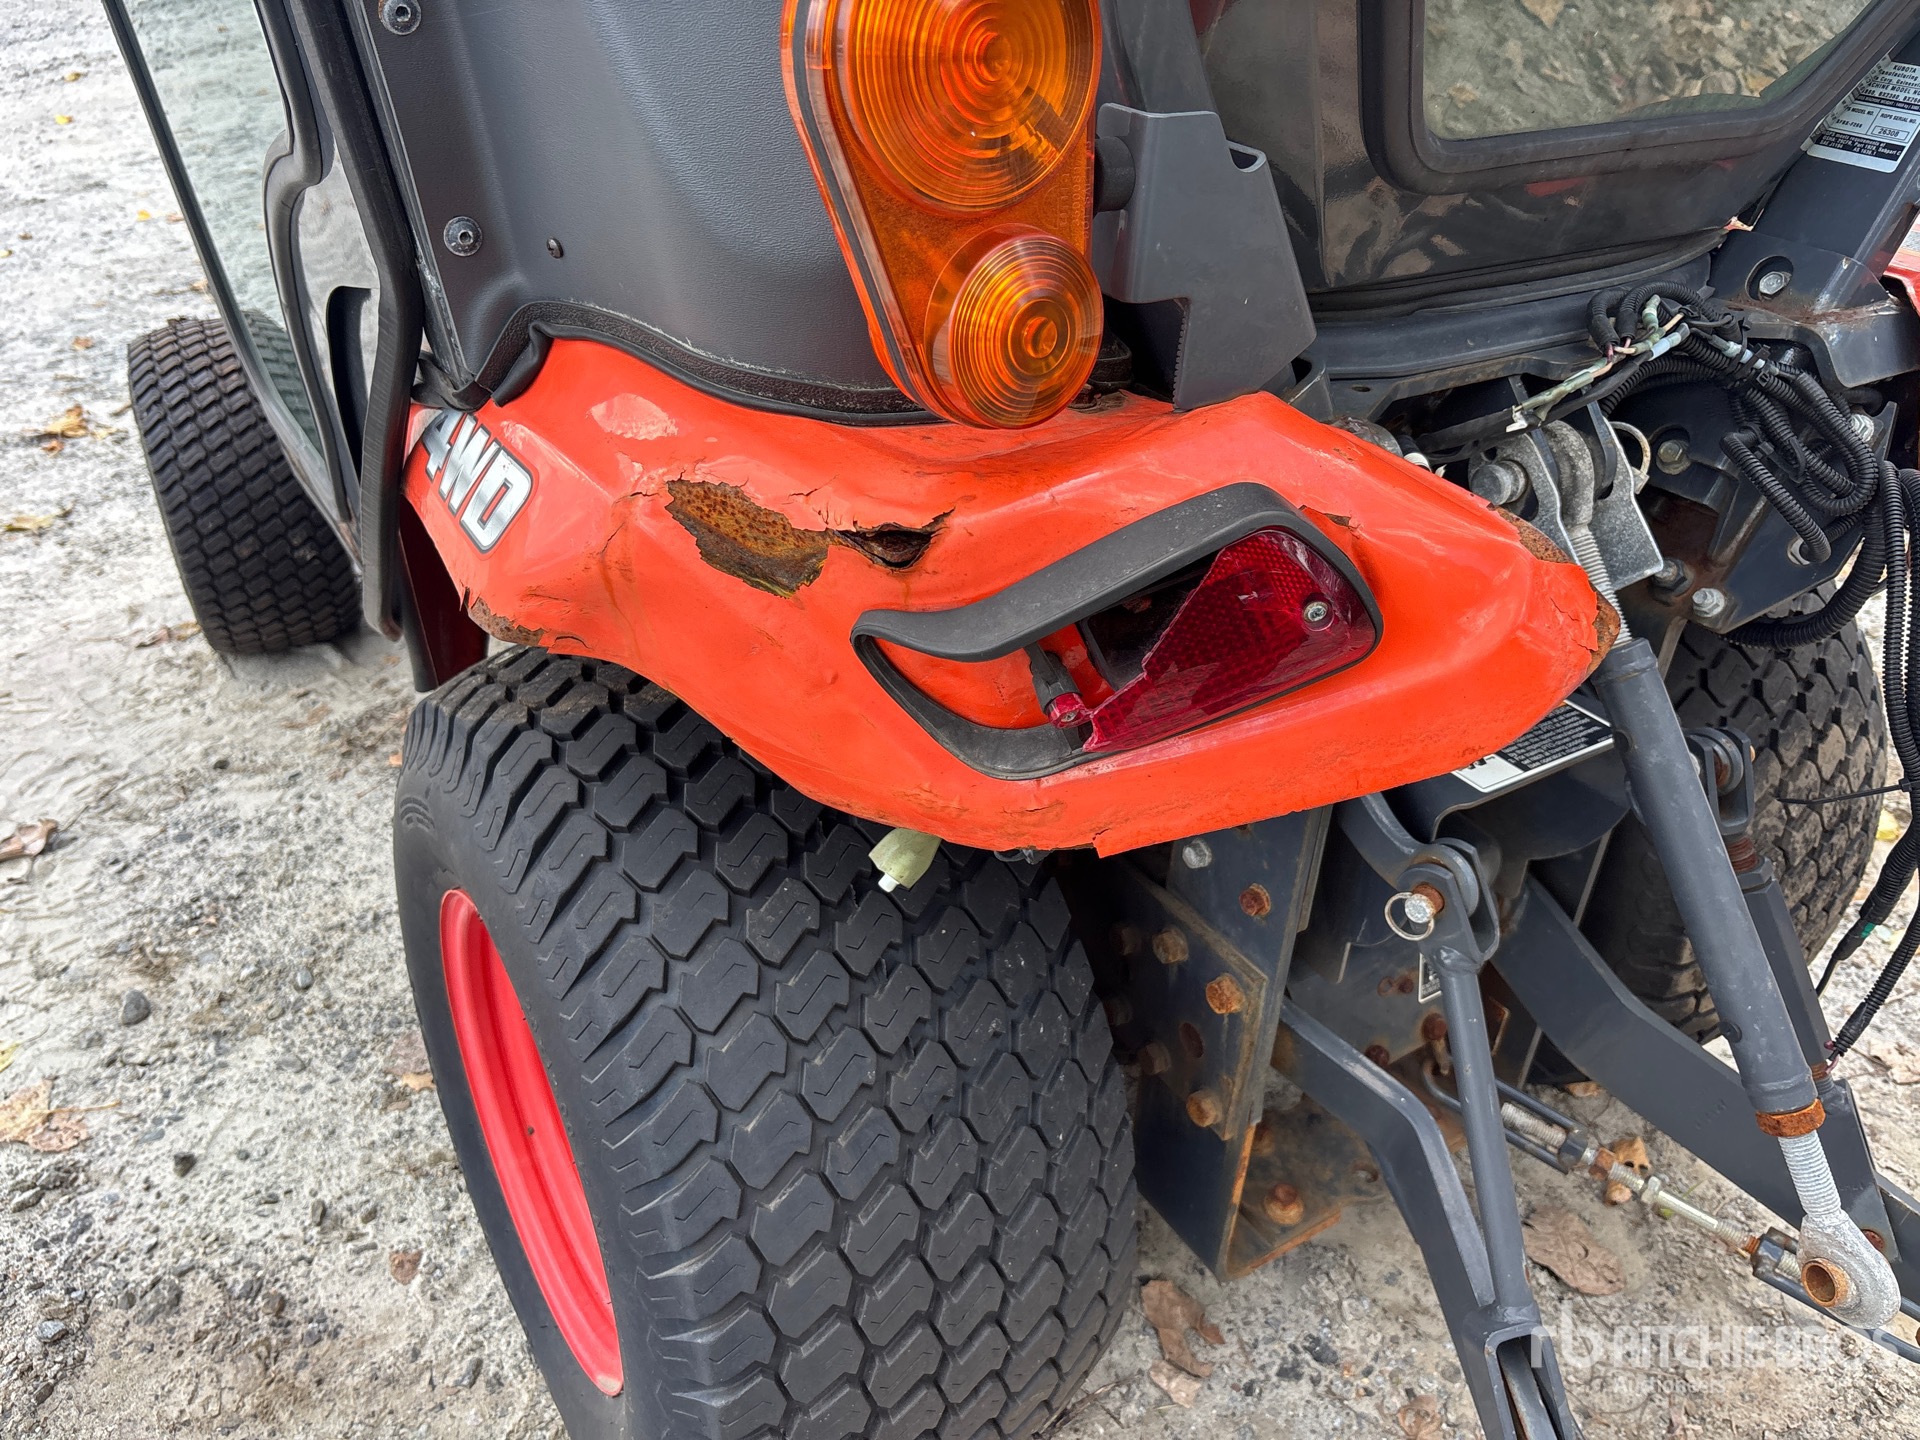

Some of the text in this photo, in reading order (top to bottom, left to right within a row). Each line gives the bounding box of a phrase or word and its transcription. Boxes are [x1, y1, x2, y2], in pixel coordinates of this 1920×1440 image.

[1893, 65, 1917, 73] KUBOTA
[1890, 86, 1911, 94] MODEL
[1893, 115, 1908, 123] SERIAL
[1877, 128, 1900, 138] 26308
[1850, 136, 1880, 146] requirements
[1878, 147, 1897, 155] Subpart
[421, 408, 533, 554] 4WD
